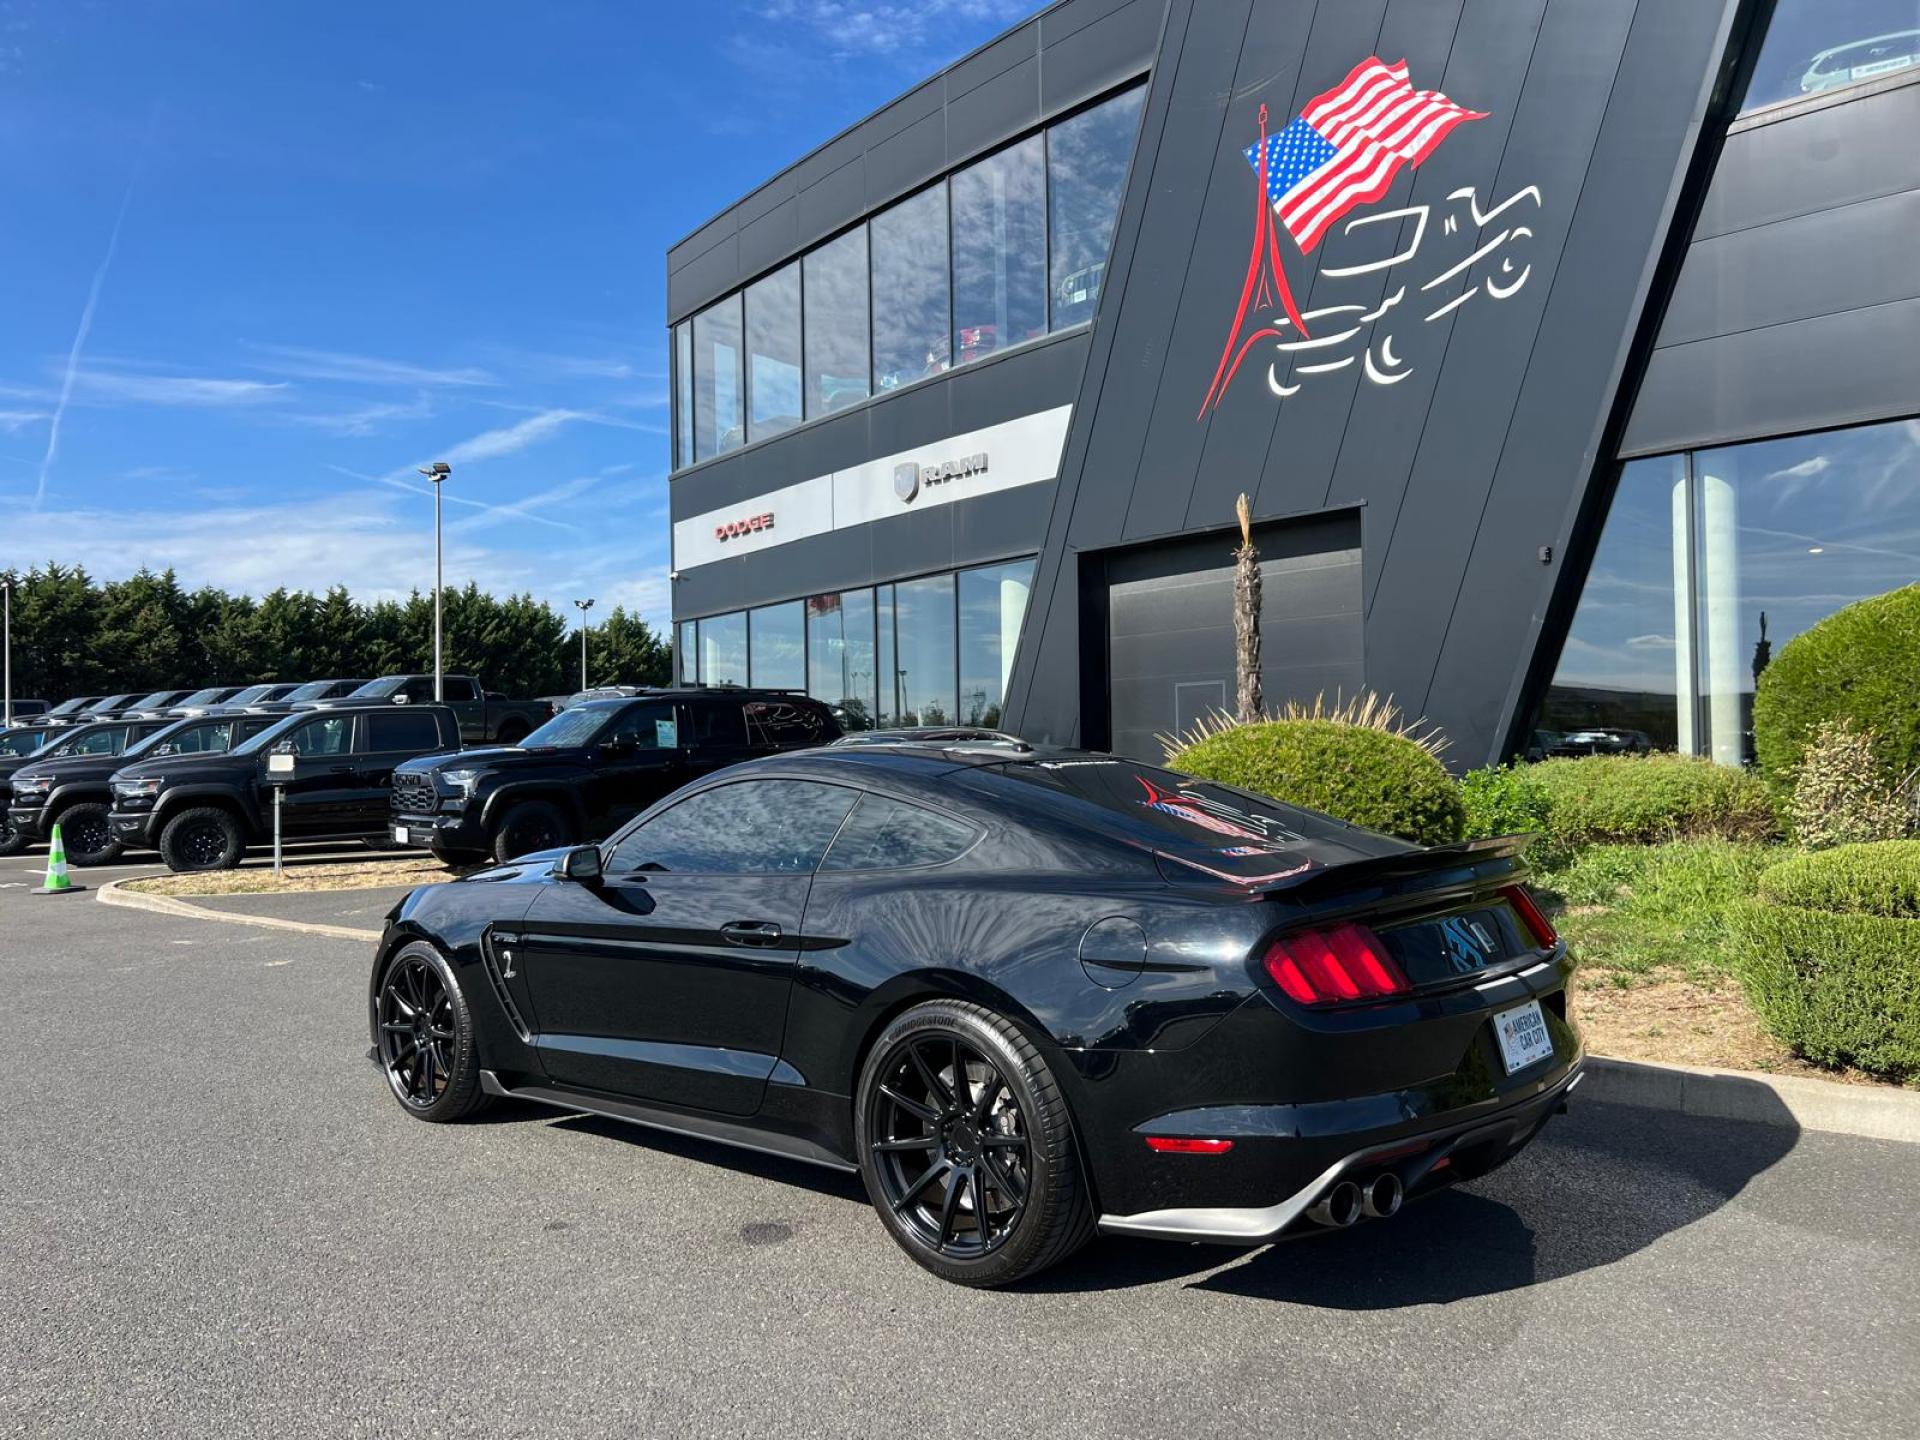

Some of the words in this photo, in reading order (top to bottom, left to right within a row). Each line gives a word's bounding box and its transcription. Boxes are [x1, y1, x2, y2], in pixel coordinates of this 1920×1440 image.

[921, 453, 988, 486] RAM
[714, 512, 774, 542] DODGE
[1511, 1009, 1541, 1033] AMERICAN
[1520, 1031, 1533, 1050] CAR
[1532, 1026, 1546, 1045] CITY
